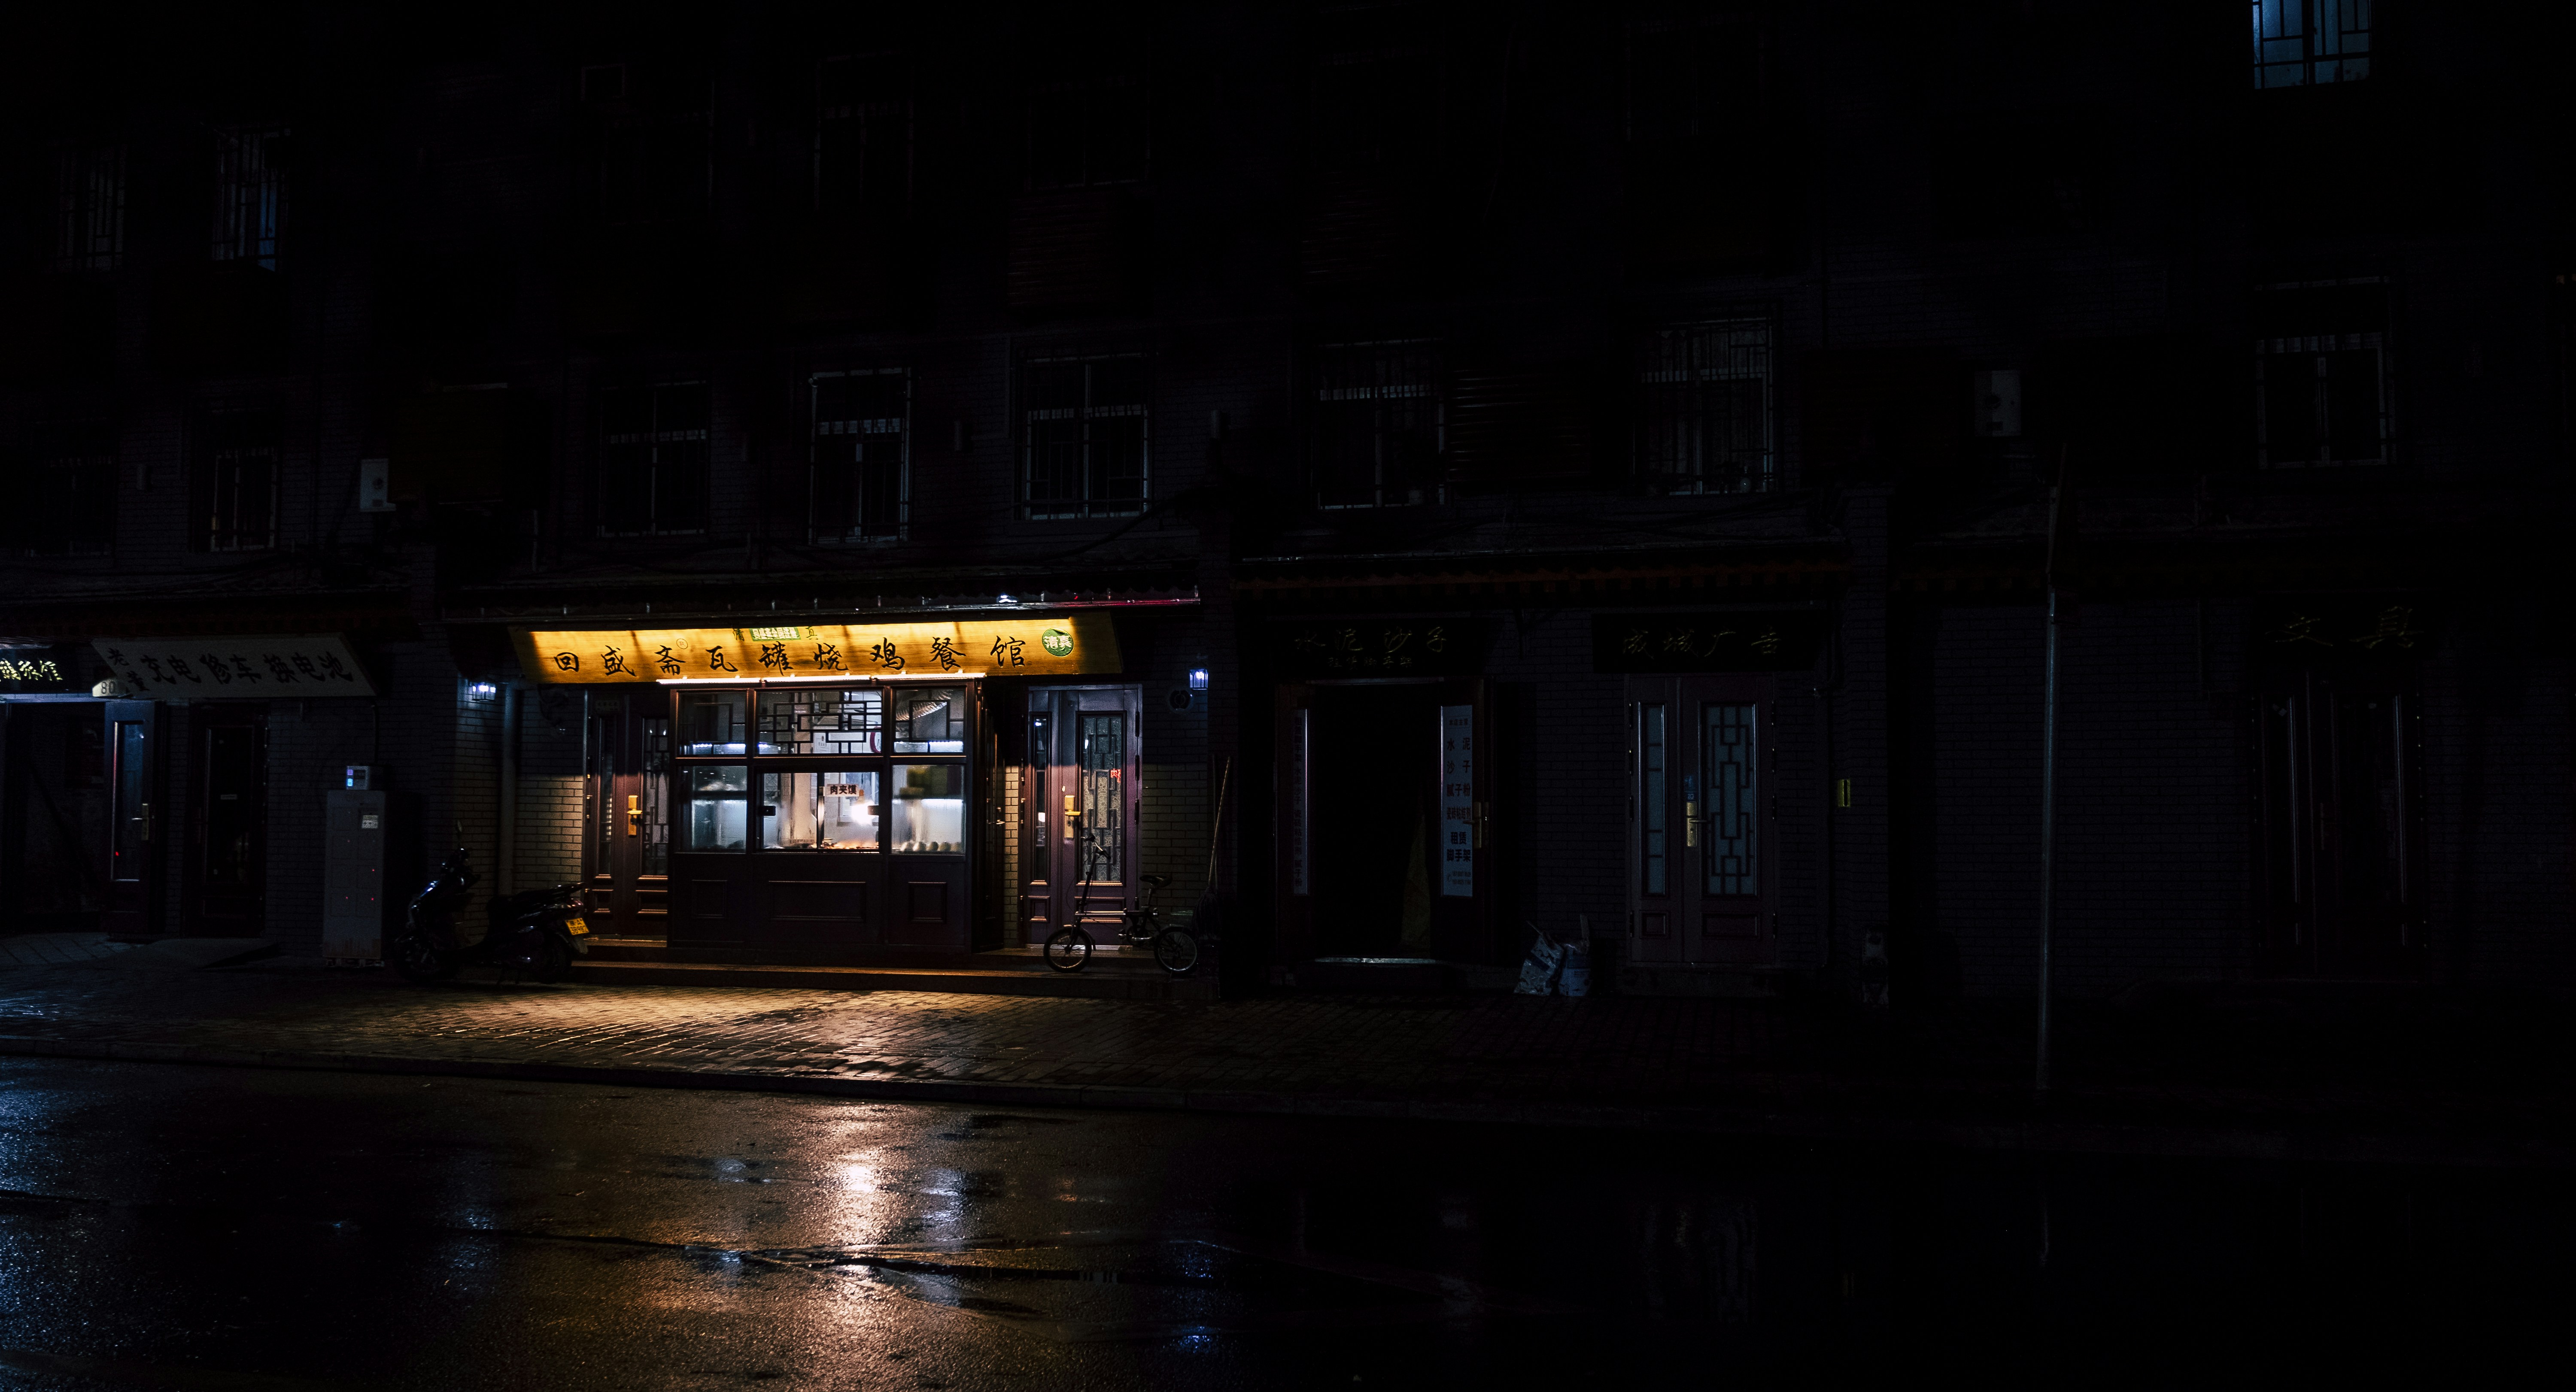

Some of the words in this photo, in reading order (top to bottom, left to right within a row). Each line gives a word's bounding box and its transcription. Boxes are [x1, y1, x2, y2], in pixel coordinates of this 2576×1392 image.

[2265, 607, 2425, 649] 文具
[1043, 635, 1072, 648] 清真
[1294, 625, 1447, 654] 水泥沙子
[553, 635, 1026, 676] 回盛斋瓦罐烧鸡餐馆
[108, 648, 150, 691] 老董
[140, 651, 352, 684] 充电修车换电池
[101, 681, 115, 694] 80
[1447, 737, 1470, 751] 水泥
[1447, 760, 1470, 773] 沙子
[830, 785, 857, 795] 肉夹馍
[1447, 783, 1470, 797] 腻子粉
[1451, 831, 1467, 844] 租赁
[1446, 849, 1471, 862] 脚手架
